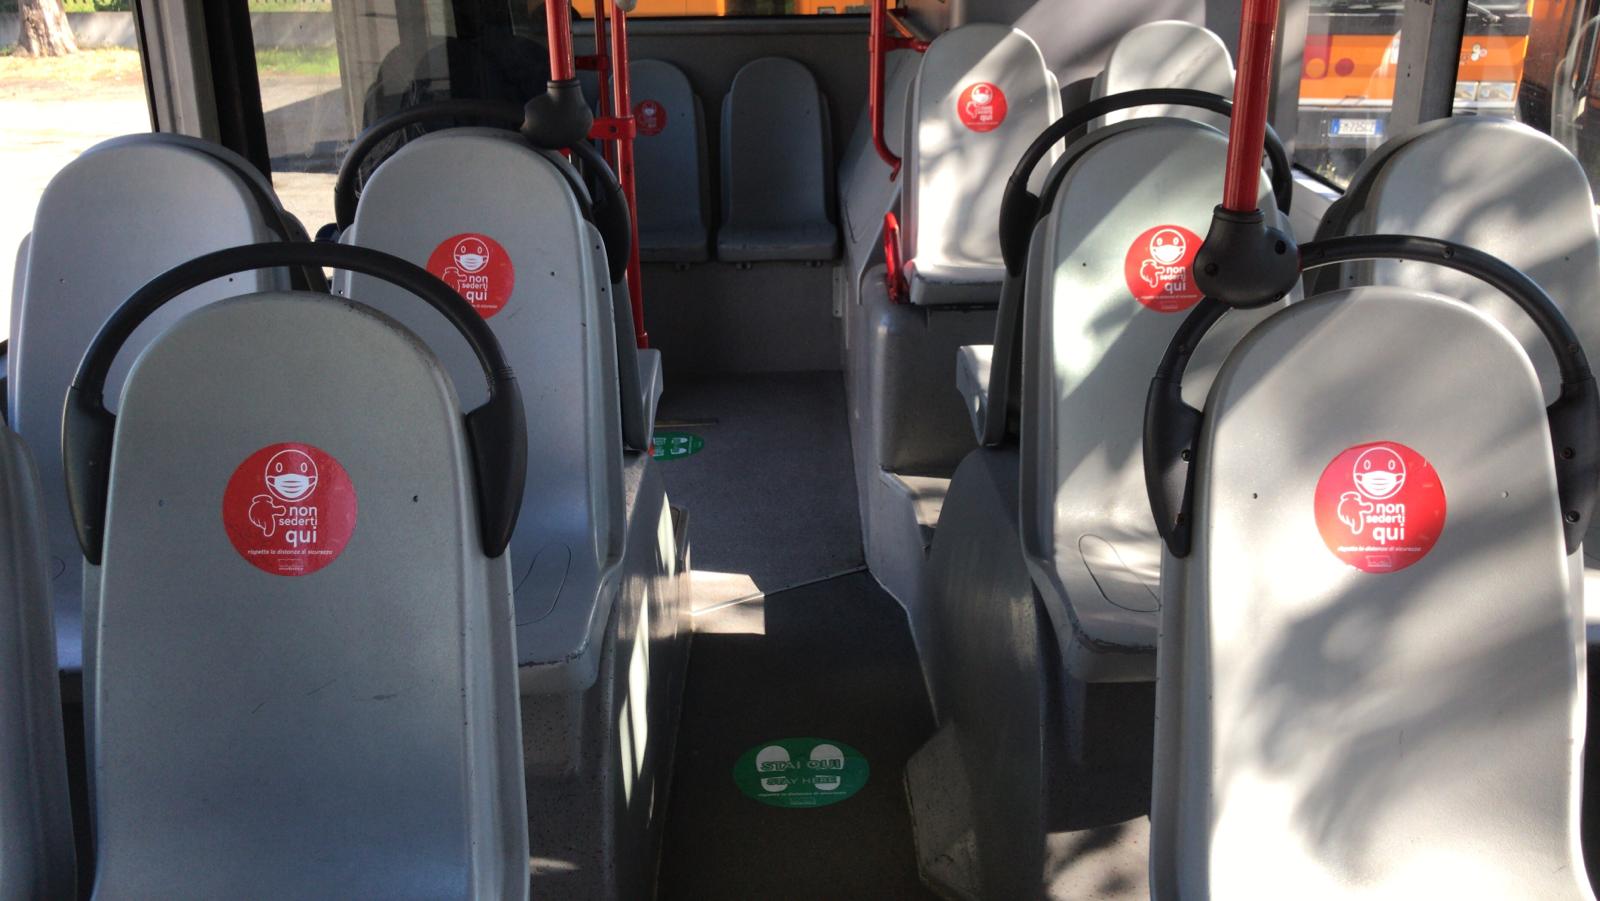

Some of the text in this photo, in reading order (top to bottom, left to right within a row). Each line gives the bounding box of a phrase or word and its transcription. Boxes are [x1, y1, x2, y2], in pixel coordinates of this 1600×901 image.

[1166, 266, 1187, 275] non
[468, 275, 489, 283] non
[1164, 281, 1187, 294] qui
[466, 288, 488, 303] qui
[289, 506, 318, 517] non
[1376, 503, 1406, 514] non
[278, 516, 318, 526] sederti
[1365, 513, 1406, 524] sederti
[285, 526, 317, 547] qui
[1372, 524, 1406, 545] qui
[760, 758, 842, 771] STAI QUI
